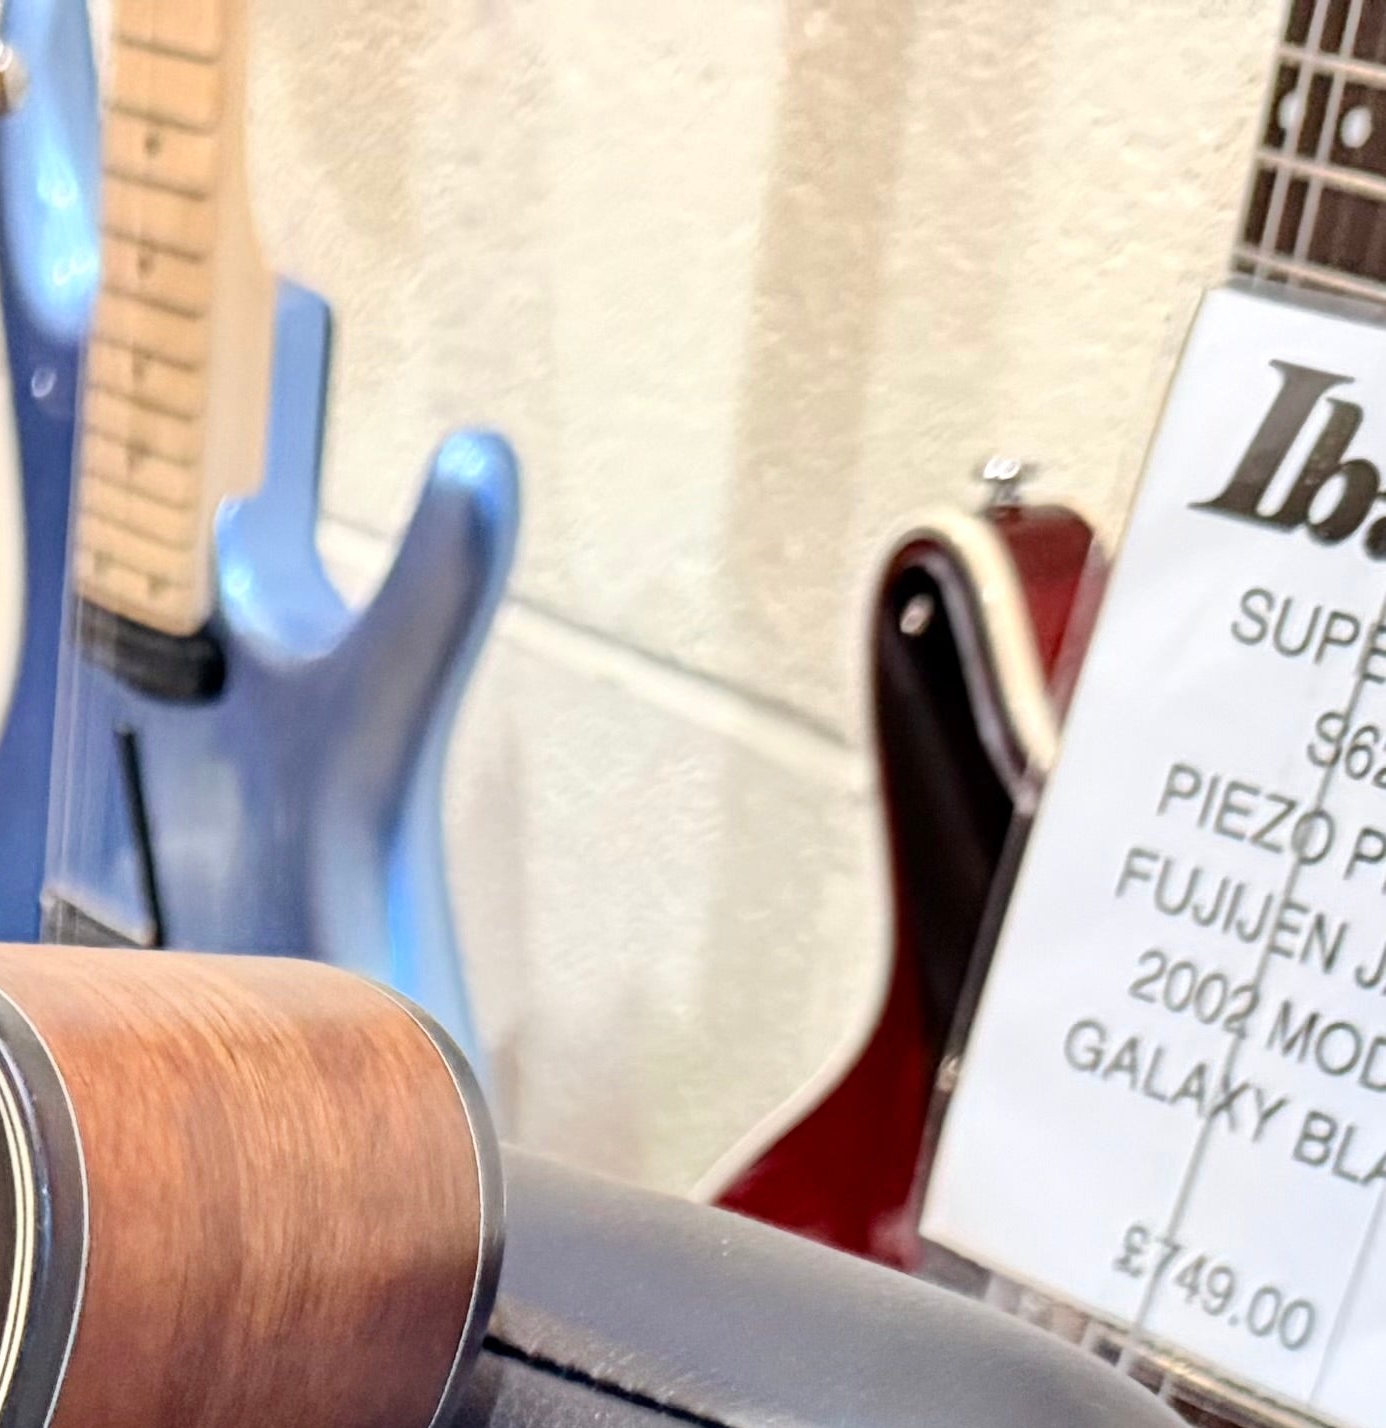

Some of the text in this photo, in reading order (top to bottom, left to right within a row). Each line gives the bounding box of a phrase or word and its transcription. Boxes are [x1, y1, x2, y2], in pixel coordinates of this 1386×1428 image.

[1186, 359, 1386, 563] Ib
[1157, 763, 1336, 866] PIEZO
[1115, 847, 1349, 974] FUJIJEN
[1128, 948, 1260, 1040] 2002
[1064, 1019, 1290, 1142] GALAXY
[1113, 1224, 1317, 1351] £749.00
